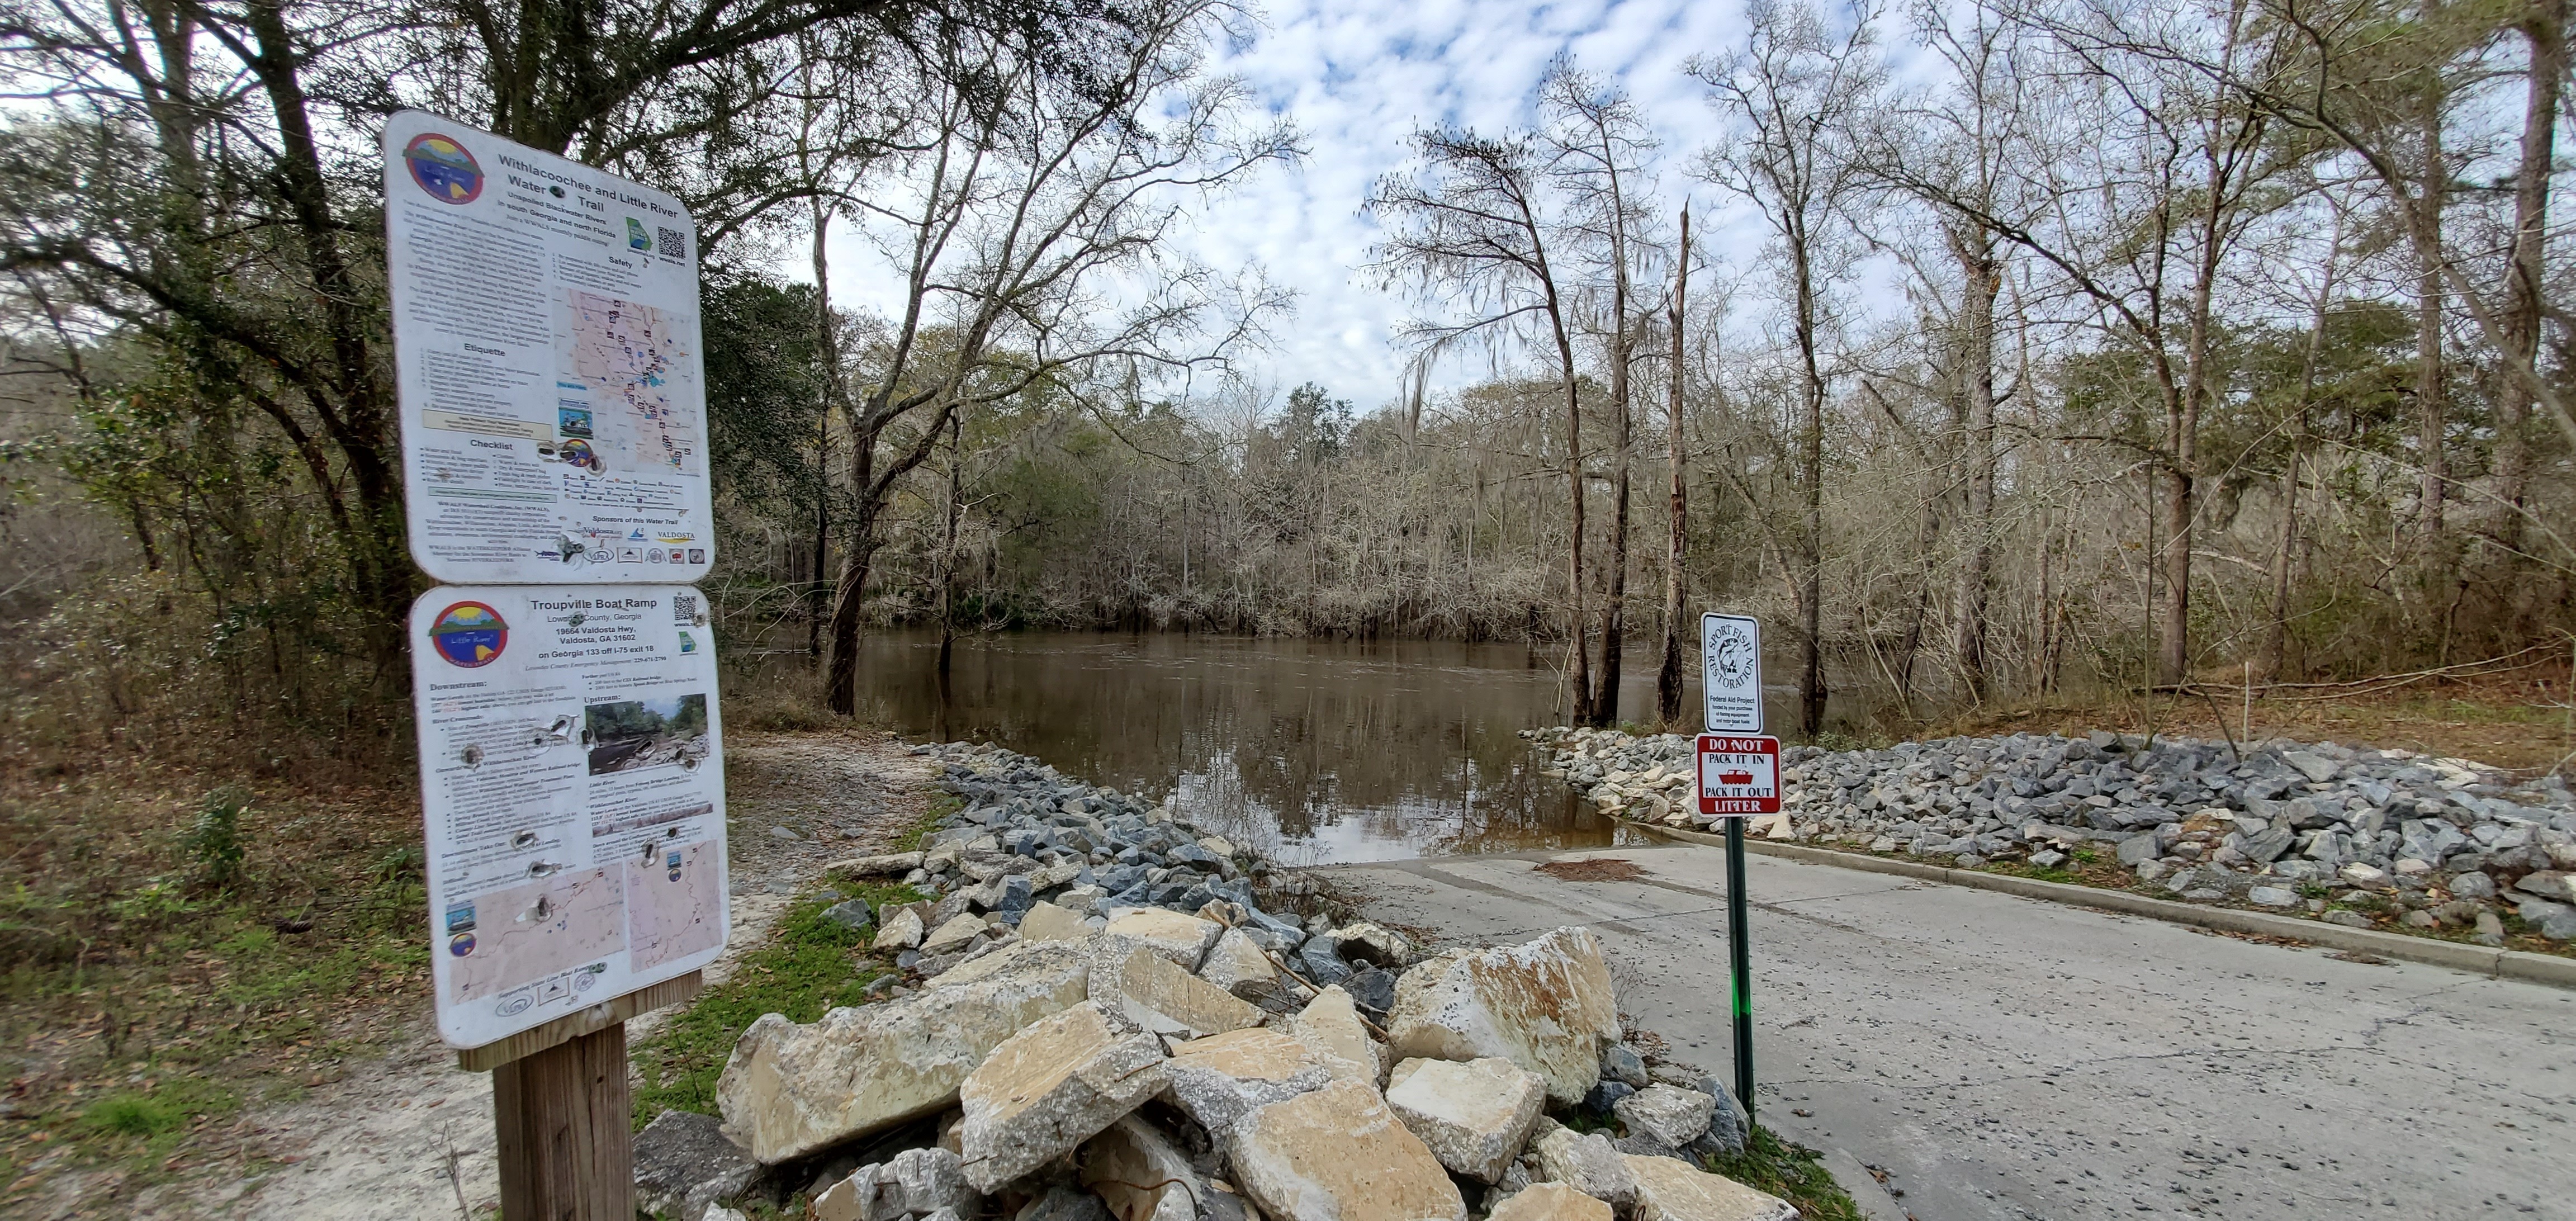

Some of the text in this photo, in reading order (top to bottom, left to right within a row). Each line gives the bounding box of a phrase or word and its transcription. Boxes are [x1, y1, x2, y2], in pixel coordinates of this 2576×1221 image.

[498, 153, 678, 219] Withlacoochee and Little River
[508, 174, 604, 212] Water Trail
[508, 191, 607, 225] Unspoiled Blackwater Rivers
[507, 202, 528, 213] south
[530, 209, 557, 223] Georgia
[560, 217, 572, 225] and
[574, 220, 591, 231] north
[594, 226, 616, 238] Florida
[609, 256, 633, 269] Safety
[464, 343, 505, 357] Etiquette
[470, 439, 513, 450] Checklist
[531, 599, 657, 612] Troupville Boat Ramp
[584, 614, 612, 622] County,
[1709, 624, 1752, 652] SPORT FISH
[1708, 655, 1754, 689] RESTORATION
[429, 681, 487, 691] Downstream:
[584, 694, 621, 703] Upstream:
[1710, 739, 1763, 751] DO NOT
[1709, 754, 1764, 764] PACK IT IN
[1706, 787, 1771, 797] PACK IT OUT
[1715, 801, 1761, 812] LITTER
